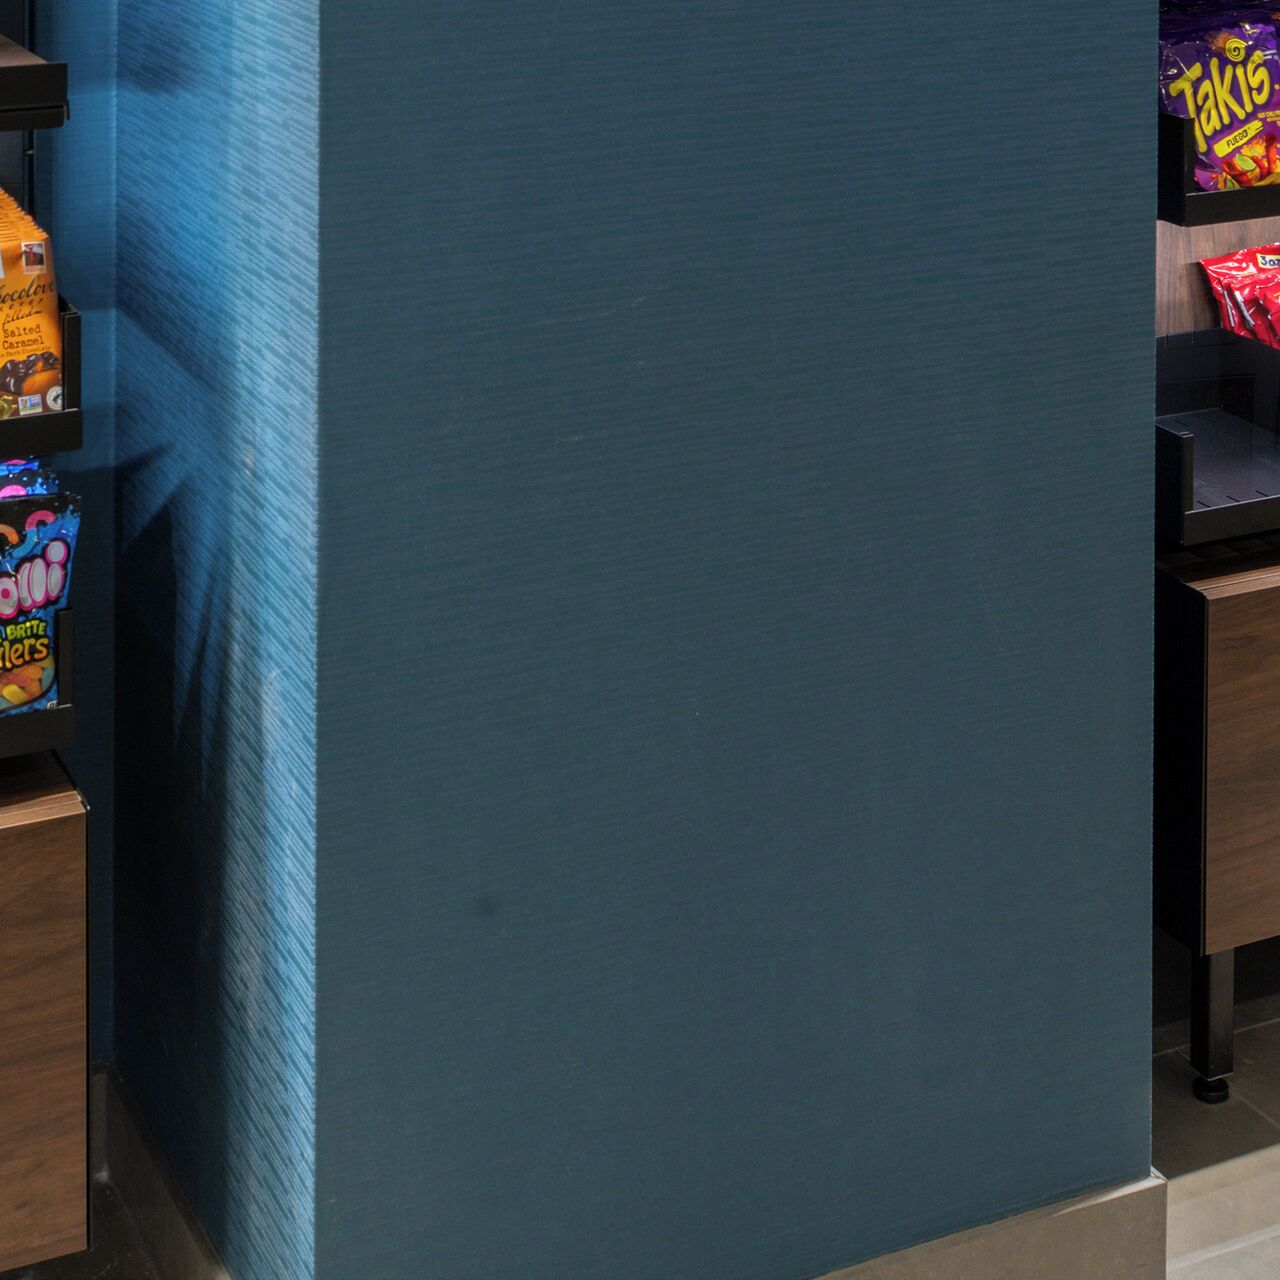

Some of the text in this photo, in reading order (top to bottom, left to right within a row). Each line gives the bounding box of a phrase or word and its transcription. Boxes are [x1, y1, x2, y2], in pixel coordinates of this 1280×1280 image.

[1169, 50, 1271, 153] Takis
[1225, 129, 1249, 149] FUEGO
[3, 323, 42, 339] Salted
[2, 335, 45, 351] Caramel
